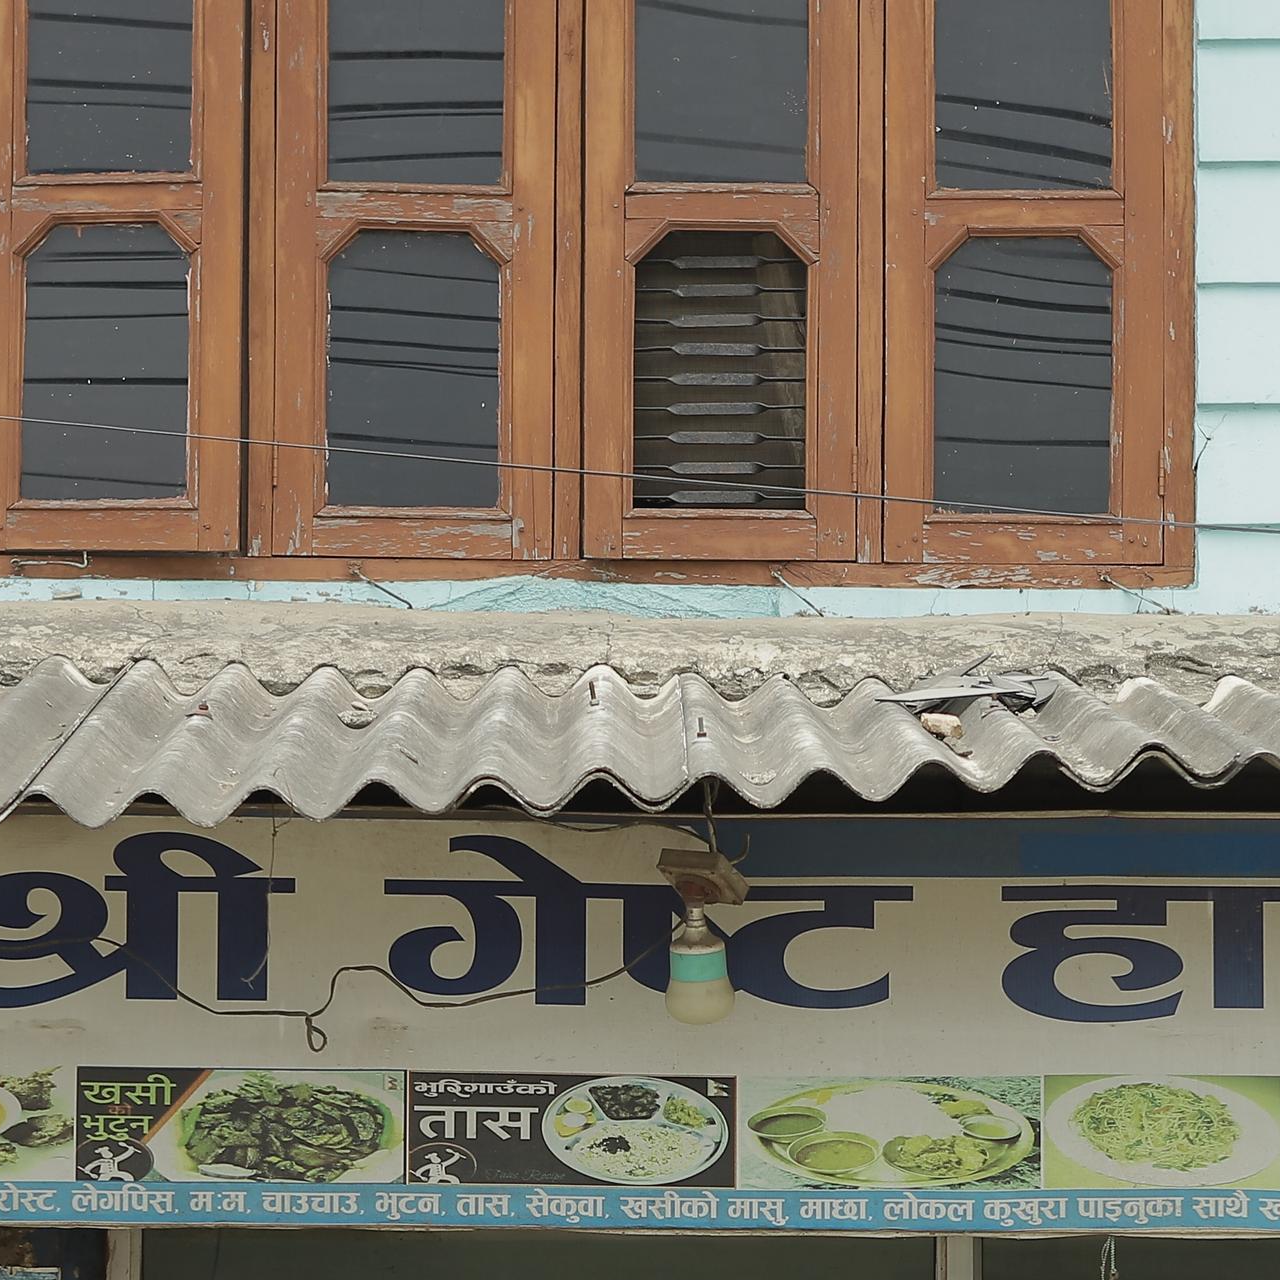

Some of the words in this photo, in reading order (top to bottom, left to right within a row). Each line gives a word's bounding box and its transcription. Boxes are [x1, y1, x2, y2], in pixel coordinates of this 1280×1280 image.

[80, 1073, 177, 1106] खसी
[413, 1105, 540, 1141] तास
[620, 1190, 719, 1220] खसीको
[883, 1192, 975, 1221] लोकल
[983, 1197, 1069, 1226] कुखुरा
[1192, 1191, 1250, 1221] साथै
